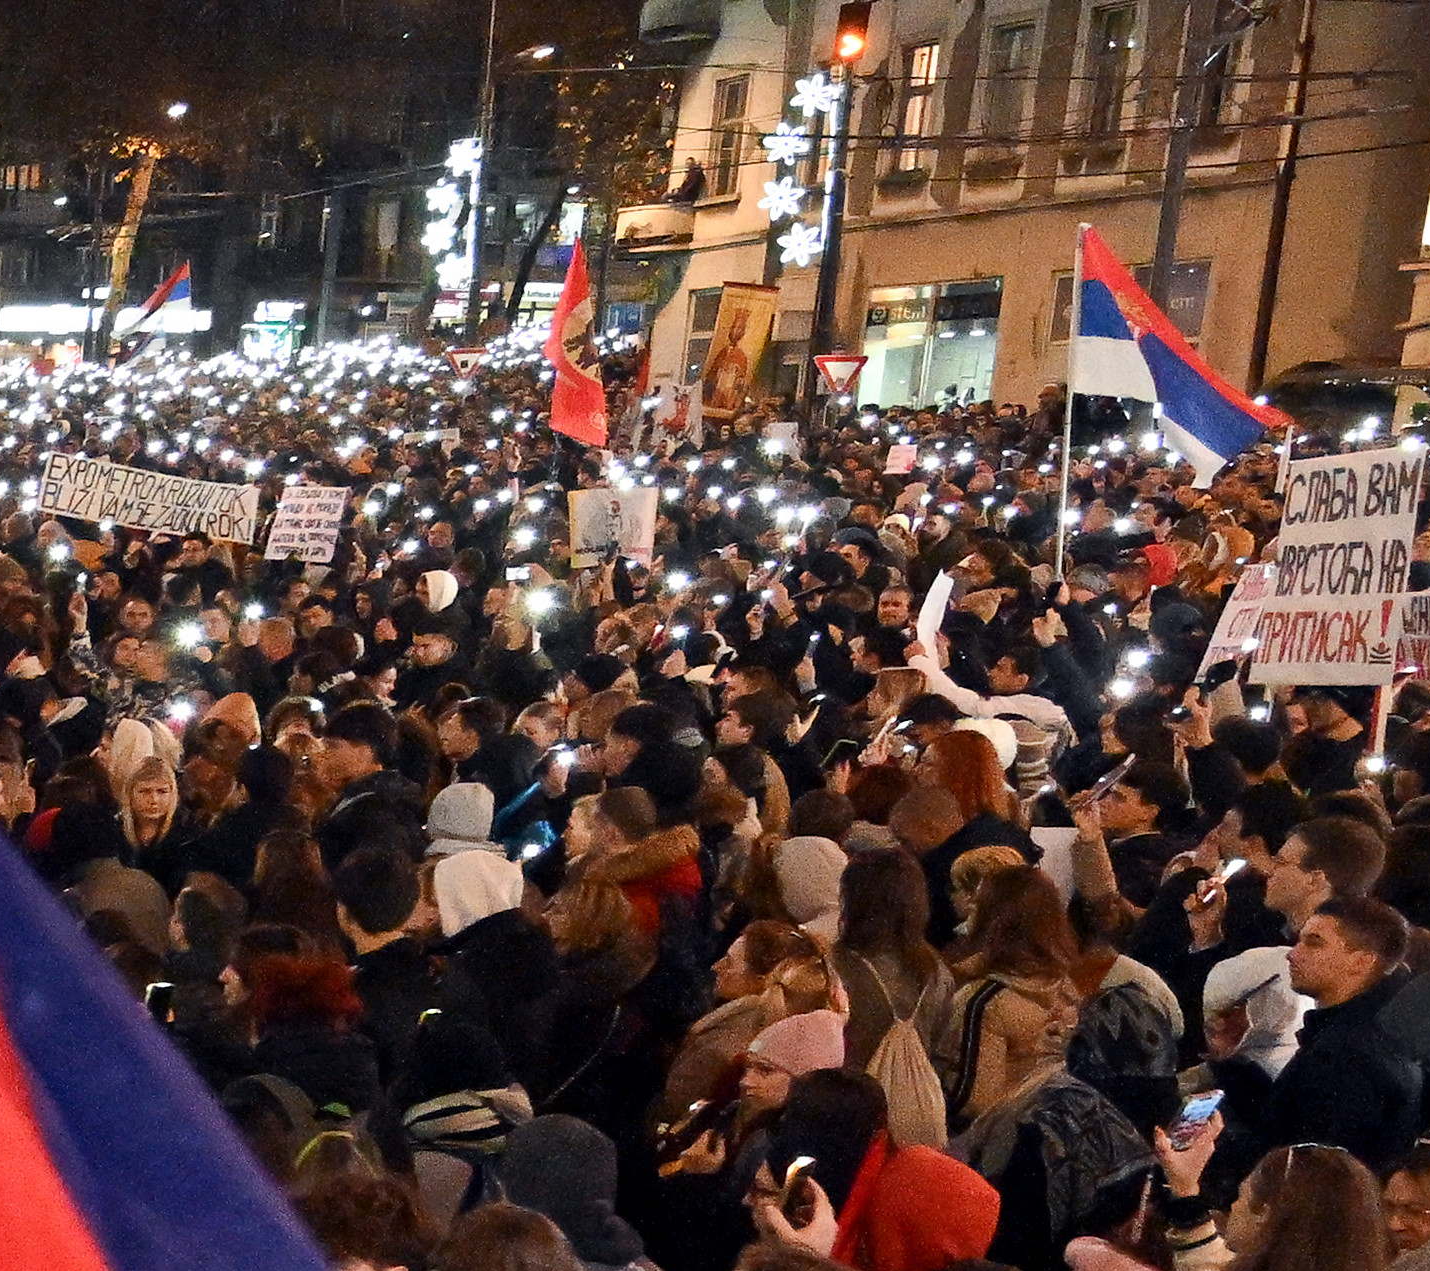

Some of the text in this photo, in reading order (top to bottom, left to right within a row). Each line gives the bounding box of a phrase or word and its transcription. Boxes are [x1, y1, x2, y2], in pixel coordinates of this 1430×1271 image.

[41, 482, 91, 512] BLIZI
[98, 493, 133, 523] VAM
[1285, 458, 1422, 525] СЛАБА ВАМ
[1378, 538, 1408, 594] НА
[1254, 610, 1372, 665] ПРИТИСАК
